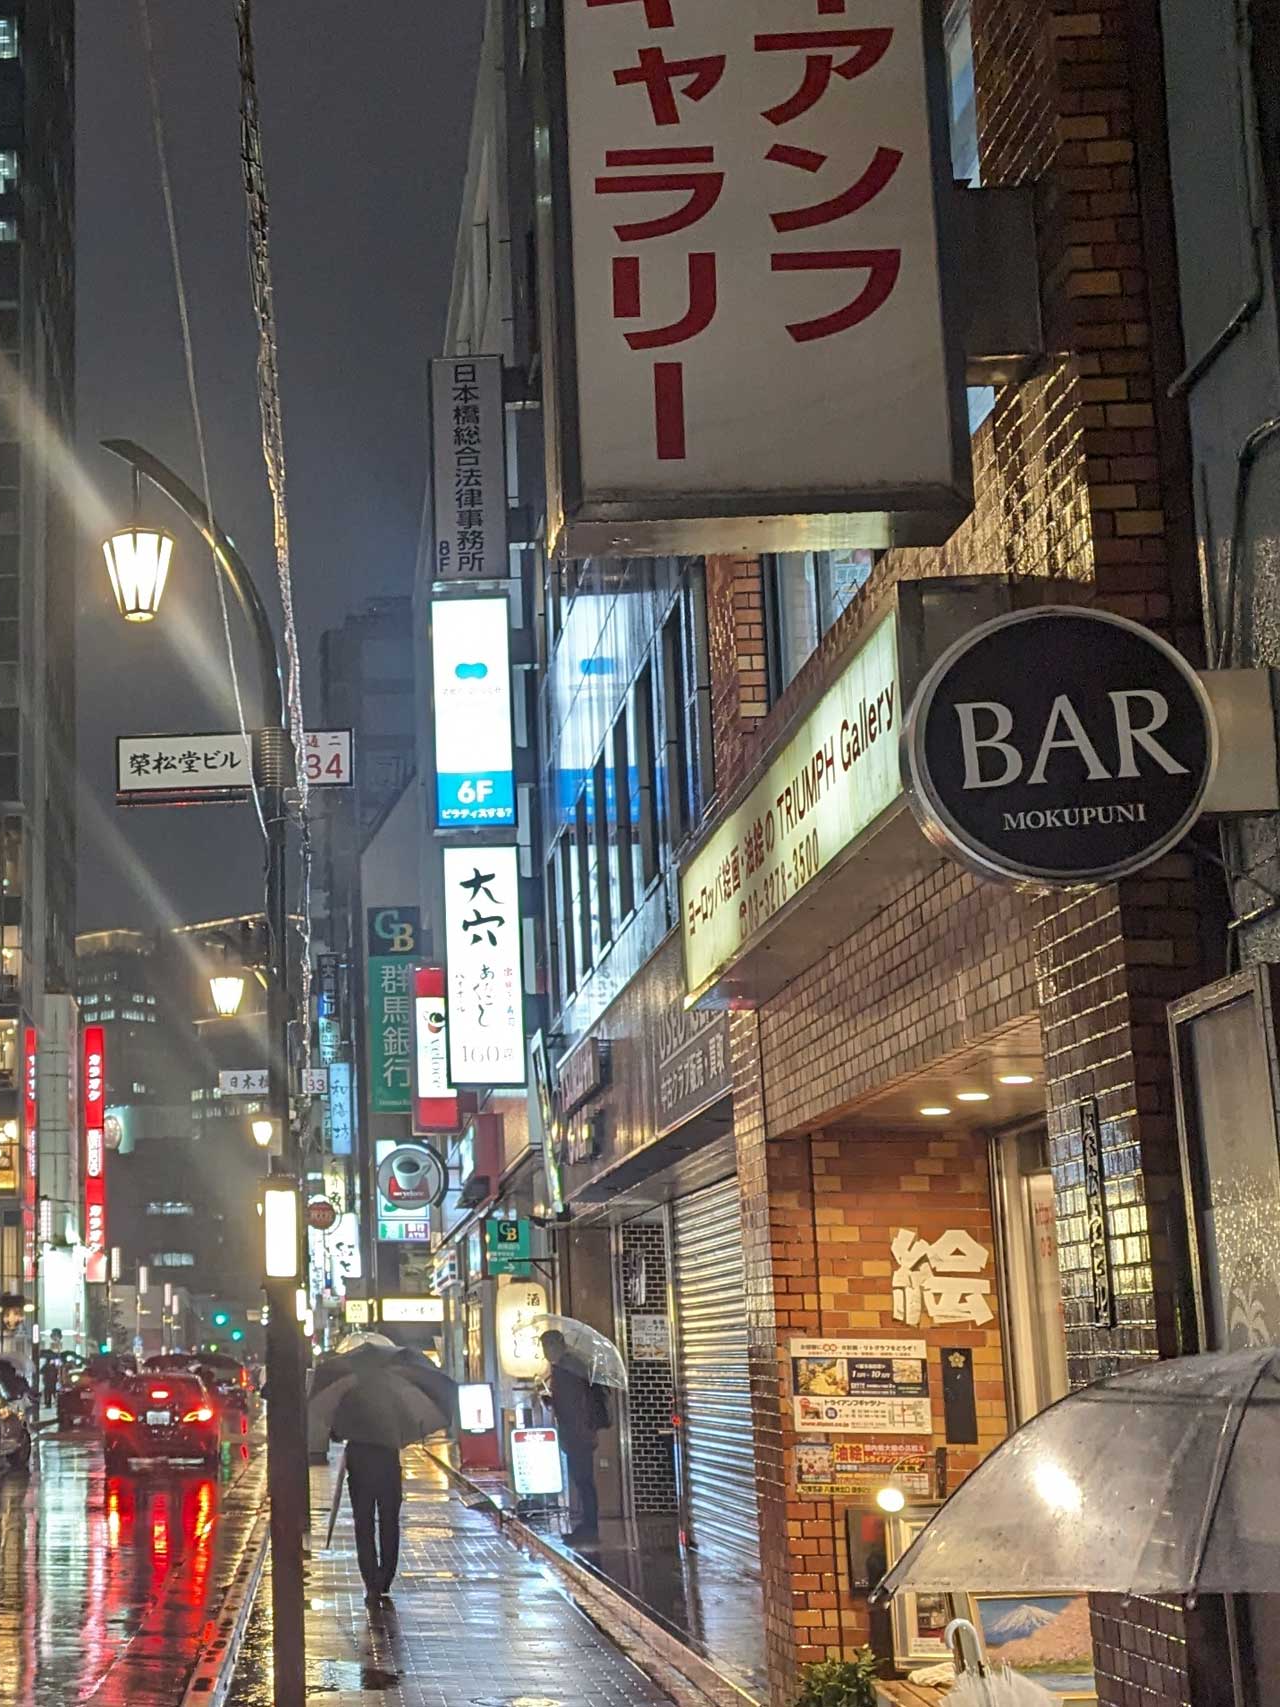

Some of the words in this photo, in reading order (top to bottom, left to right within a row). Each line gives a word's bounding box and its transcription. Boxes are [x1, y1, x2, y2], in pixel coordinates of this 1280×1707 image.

[754, 0, 904, 343] アンフ
[452, 364, 484, 572] 日本橋総合法律事務所
[306, 753, 343, 779] 34
[776, 732, 838, 841] TRIUMPH
[840, 680, 896, 773] Gallery
[954, 689, 1191, 789] BAR
[457, 779, 493, 804] 6F
[1003, 803, 1146, 831] MOKUPUNI
[374, 910, 415, 952] GB
[381, 964, 413, 1088] 群馬銀行
